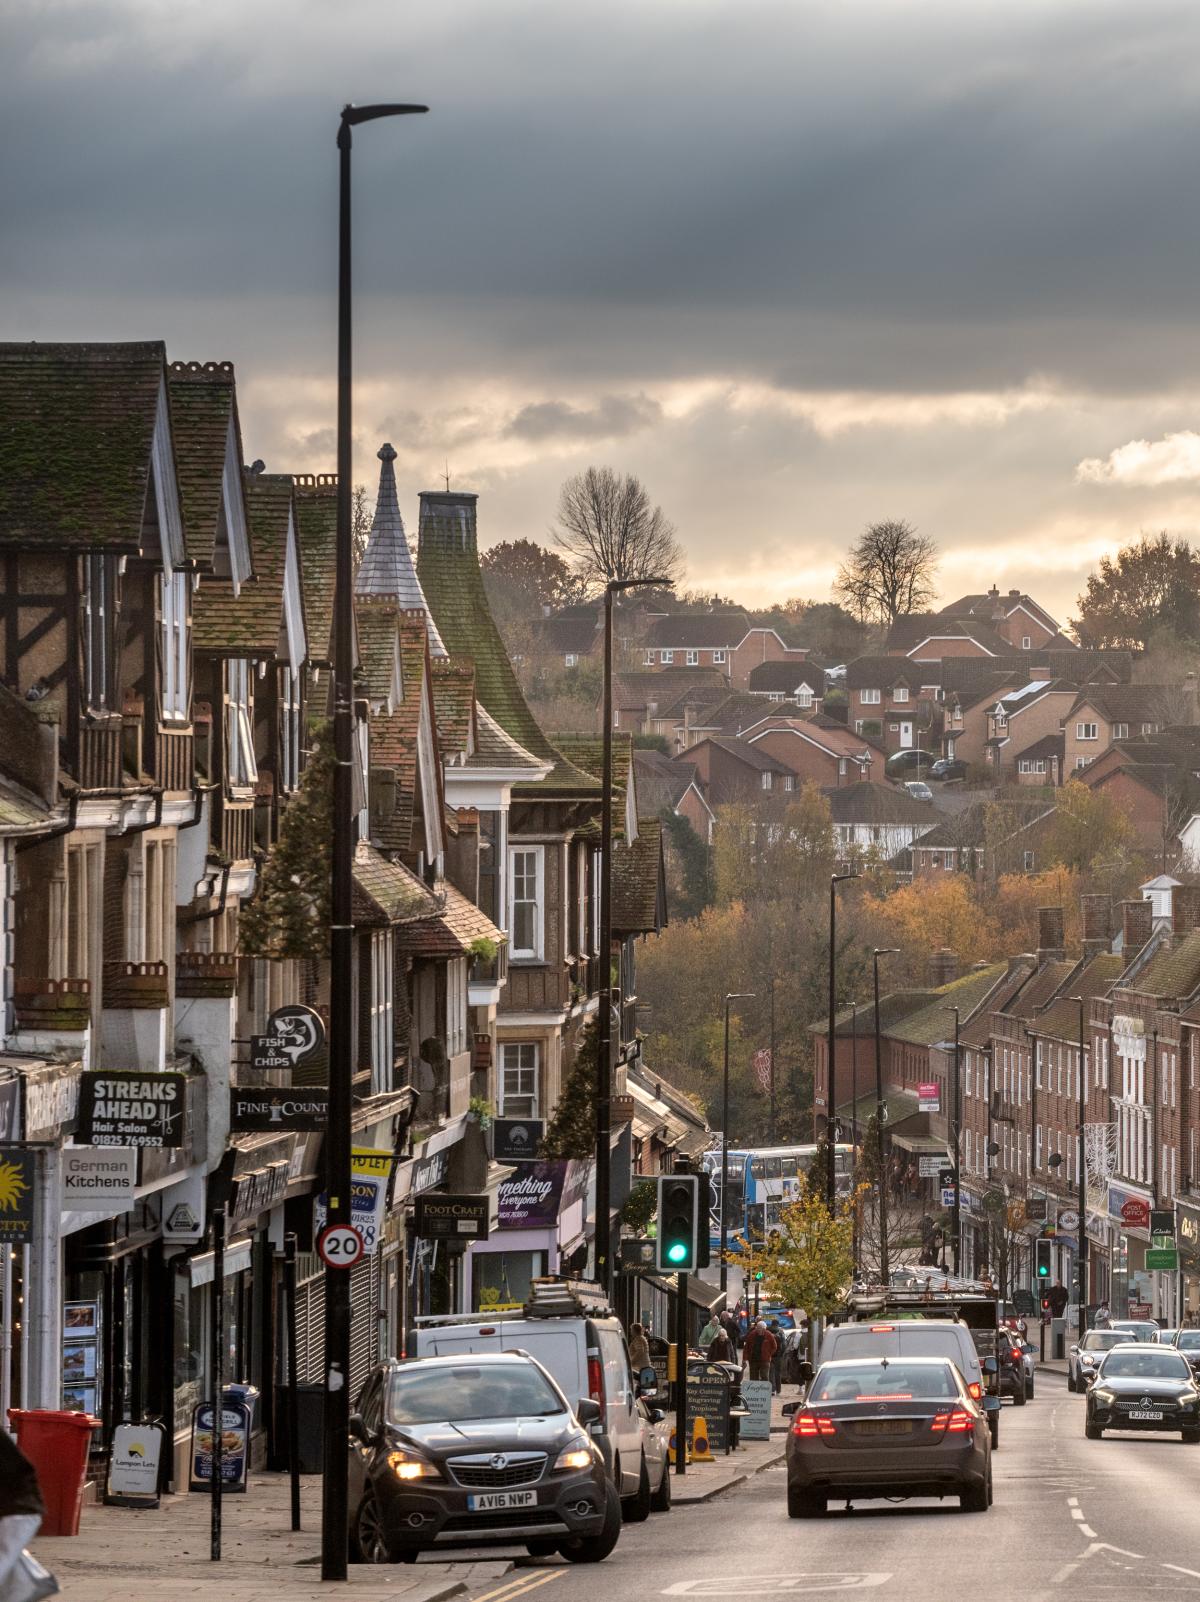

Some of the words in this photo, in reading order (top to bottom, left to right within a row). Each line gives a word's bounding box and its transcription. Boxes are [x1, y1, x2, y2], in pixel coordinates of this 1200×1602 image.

[258, 1038, 286, 1047] FISH
[267, 1048, 276, 1057] &
[255, 1058, 290, 1066] CHIPS
[94, 1080, 177, 1101] STREAKS
[92, 1101, 157, 1120] AHEAD
[236, 1101, 269, 1116] FINE
[282, 1101, 329, 1116] COUNT
[92, 1121, 115, 1132] Hair
[117, 1122, 148, 1134] Salon
[91, 1135, 122, 1146] 01825
[125, 1137, 163, 1147] 769552
[69, 1159, 128, 1172] German
[65, 1175, 130, 1188] Kitchens
[351, 1184, 376, 1197] SON
[500, 1194, 538, 1210] Everyone
[327, 1237, 358, 1255] 20
[702, 1376, 727, 1384] OPEN
[479, 1494, 506, 1508] AV16
[508, 1492, 532, 1506] NWP
